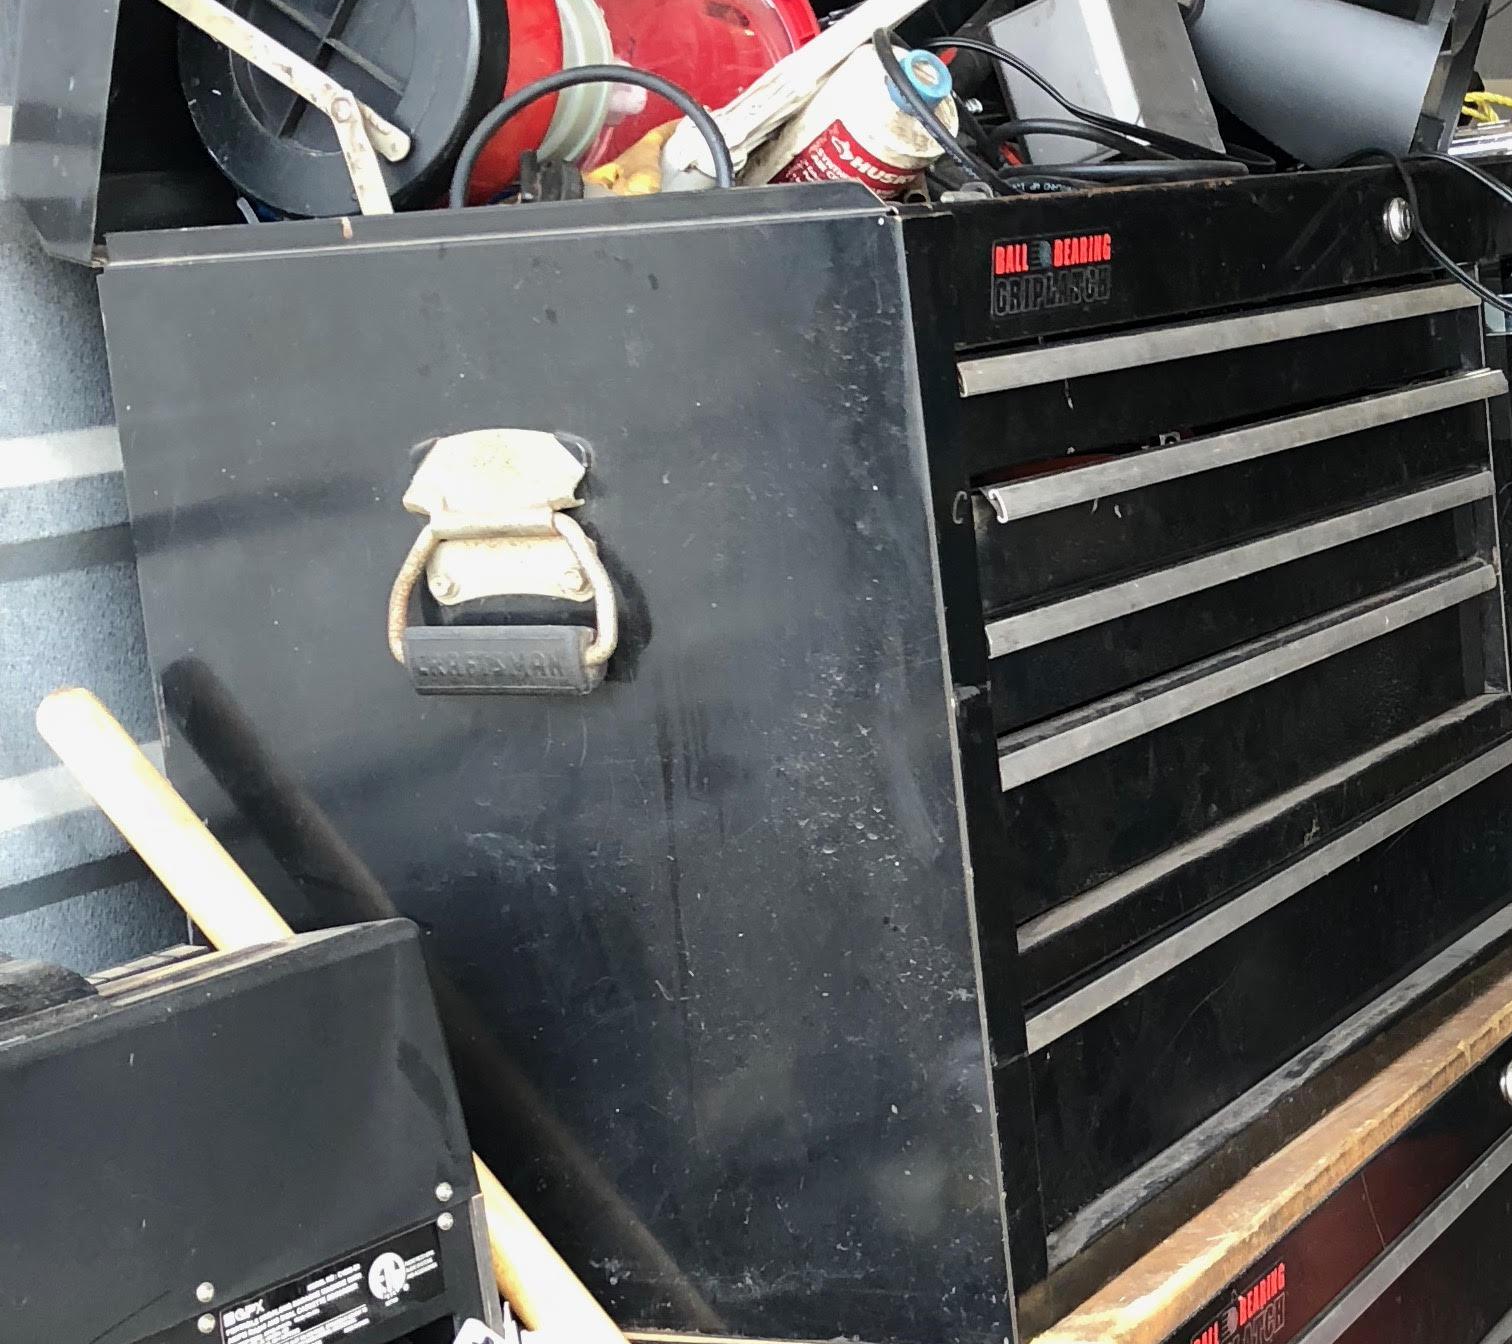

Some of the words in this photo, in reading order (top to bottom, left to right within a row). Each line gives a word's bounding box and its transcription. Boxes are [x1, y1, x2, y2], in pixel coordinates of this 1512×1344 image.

[994, 243, 1029, 275] BALL
[1053, 232, 1112, 268] BEARING
[1237, 1262, 1286, 1327] BEARING
